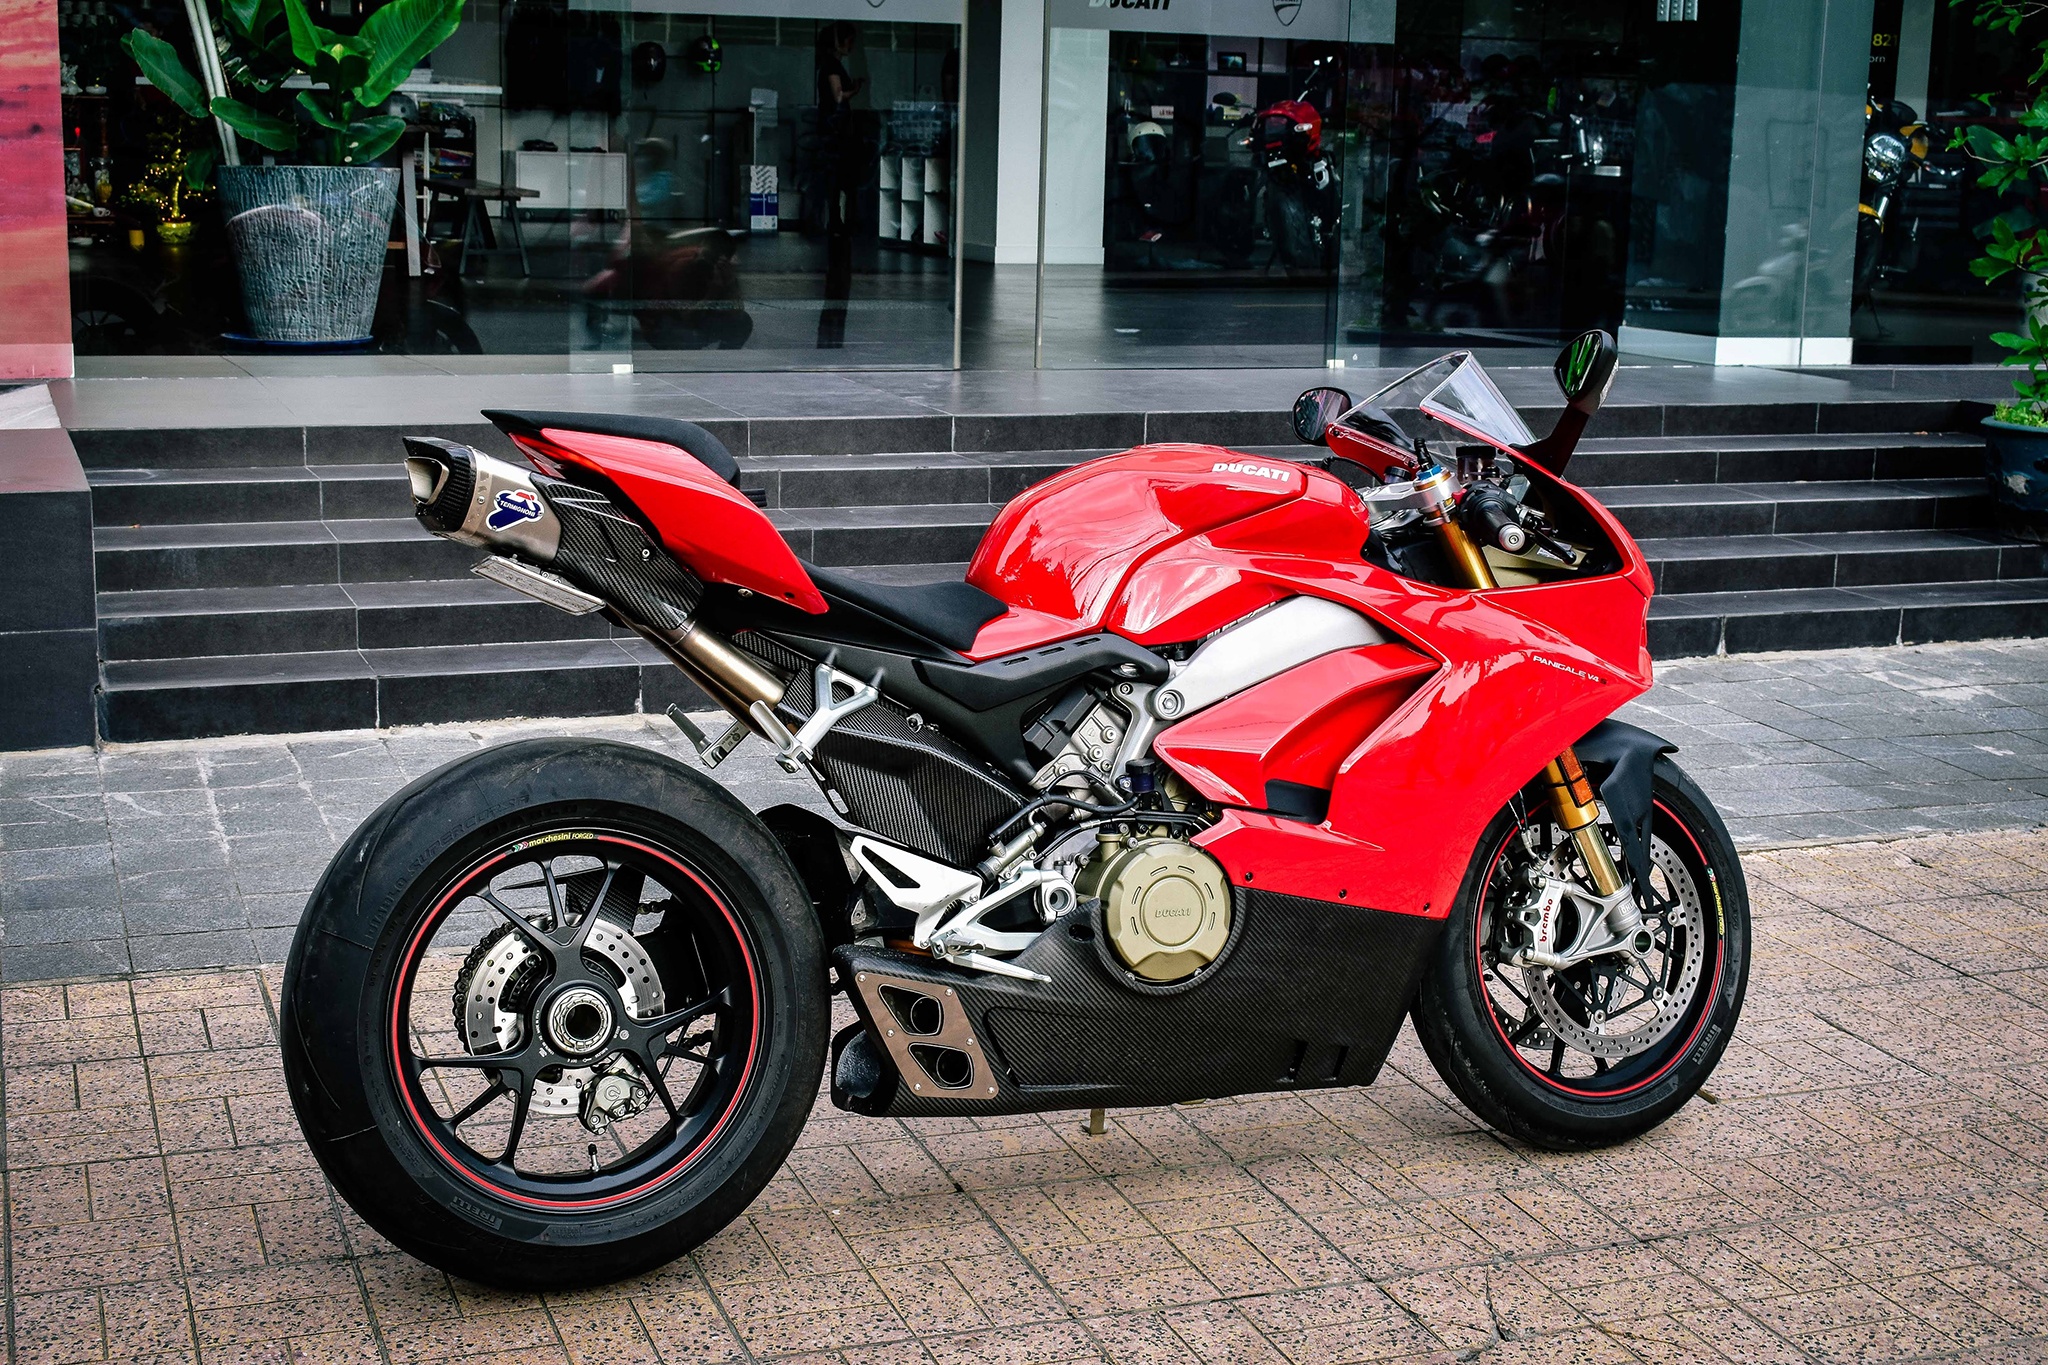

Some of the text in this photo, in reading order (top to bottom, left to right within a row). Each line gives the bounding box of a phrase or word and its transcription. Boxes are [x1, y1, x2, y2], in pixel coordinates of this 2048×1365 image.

[1212, 463, 1291, 482] DUCATI
[500, 500, 536, 517] TERMIGNONI
[1533, 655, 1587, 679] PANIGALE
[1587, 673, 1600, 682] V4
[528, 832, 594, 848] marchesini FORGED
[1154, 908, 1191, 918] DUCATI
[1540, 898, 1553, 943] brembo
[1692, 1024, 1722, 1065] PIRELLI
[451, 1195, 503, 1231] PIRELLI
